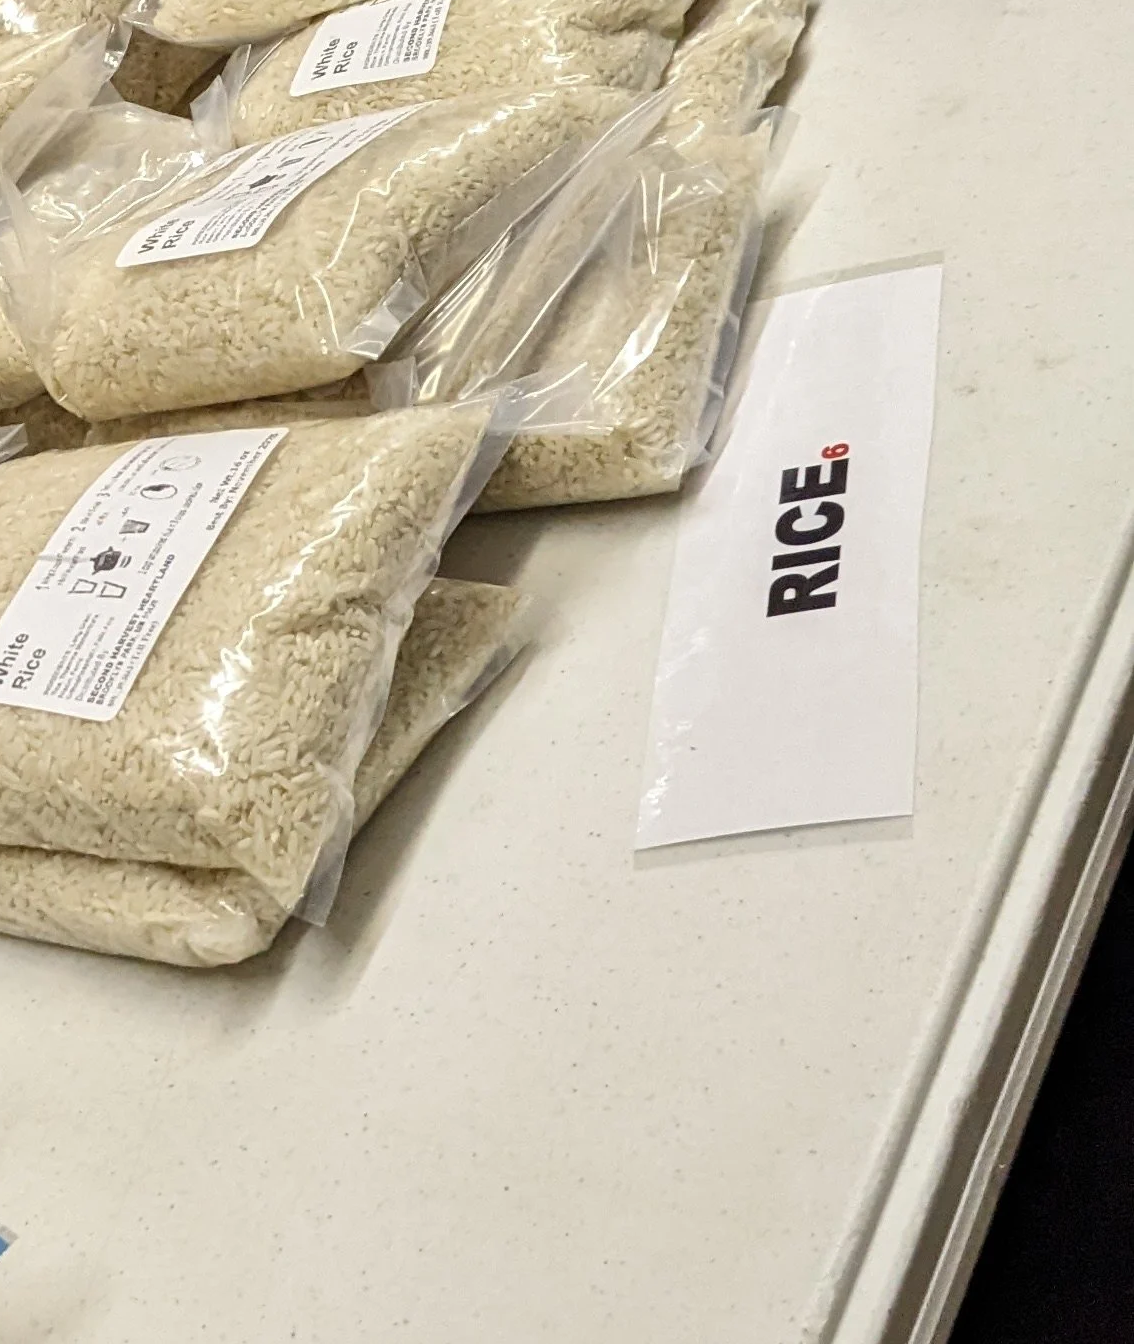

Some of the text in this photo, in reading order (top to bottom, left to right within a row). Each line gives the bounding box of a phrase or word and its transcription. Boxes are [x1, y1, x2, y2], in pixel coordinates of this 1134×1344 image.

[312, 38, 341, 80] White
[333, 41, 359, 75] Rice
[139, 218, 180, 254] White
[161, 219, 196, 250] Rice
[205, 511, 225, 531] Best
[228, 451, 262, 494] November
[767, 458, 849, 617] RICE
[86, 661, 114, 704] SECOND
[109, 613, 139, 660] HARVEST
[138, 554, 175, 614] HEARTLAND
[11, 648, 47, 690] Rice
